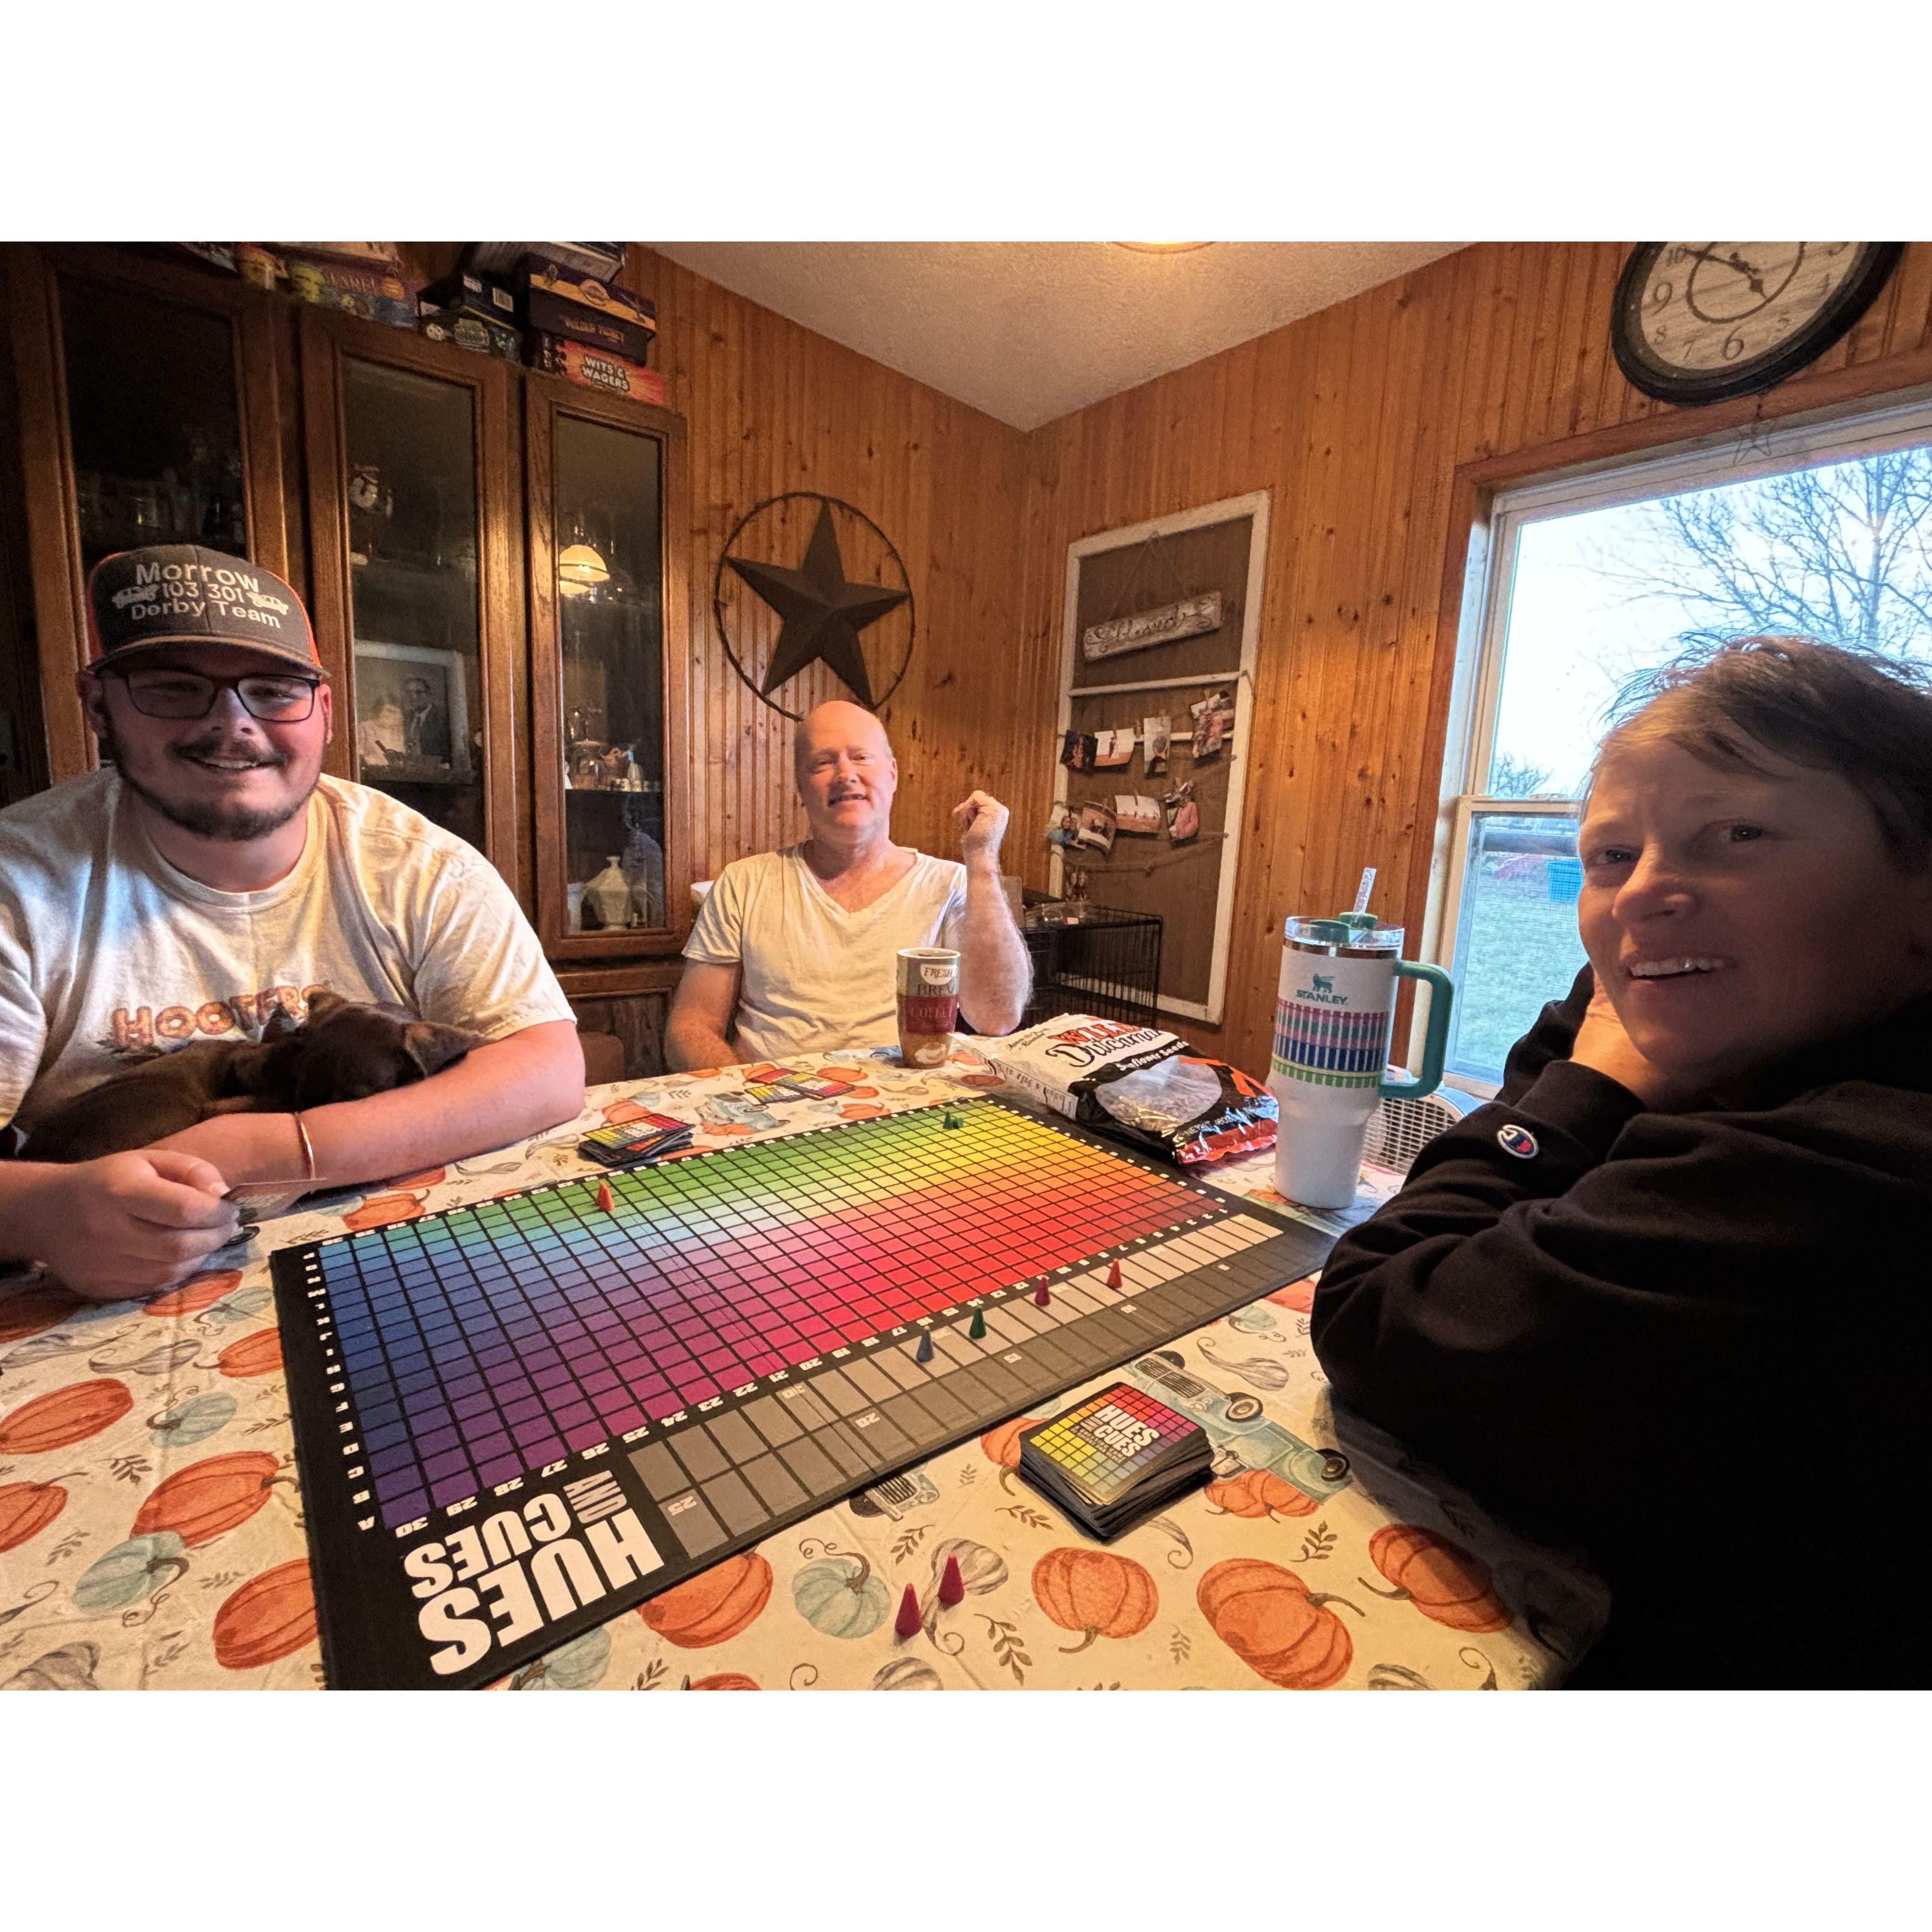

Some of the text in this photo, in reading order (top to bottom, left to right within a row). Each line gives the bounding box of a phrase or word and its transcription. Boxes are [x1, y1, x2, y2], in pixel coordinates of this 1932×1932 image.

[1653, 282, 1673, 315] 9
[1655, 325, 1666, 345] 8
[1724, 326, 1745, 360] 6
[1682, 339, 1696, 360] 7
[584, 356, 614, 374] WITS
[581, 366, 629, 390] WAGERS
[136, 562, 260, 593] Morrow
[162, 582, 242, 603] 103 301
[131, 598, 281, 629] Derby Team
[924, 967, 954, 978] FRESH
[1296, 989, 1348, 1005] STANLEY
[1046, 1023, 1142, 1045] WILD
[1116, 1040, 1190, 1071] Sunflower Seeds
[892, 1327, 907, 1336] 17
[799, 1357, 822, 1370] 20
[769, 1370, 788, 1382] 21
[733, 1383, 758, 1397] 22
[698, 1397, 723, 1411] 23
[661, 1411, 687, 1426] 24
[854, 1413, 880, 1428] 20
[1094, 1404, 1160, 1446] HUES
[623, 1426, 649, 1443] 25
[1093, 1426, 1141, 1457] CUES
[582, 1443, 609, 1459] 26
[541, 1460, 567, 1477] 27
[494, 1477, 523, 1495] 28
[447, 1496, 477, 1516] 29
[563, 1470, 627, 1524] AND
[668, 1495, 696, 1516] 25
[358, 1516, 374, 1530] A
[396, 1517, 428, 1538] 30
[404, 1493, 571, 1598] CUES
[418, 1508, 665, 1675] HUES
